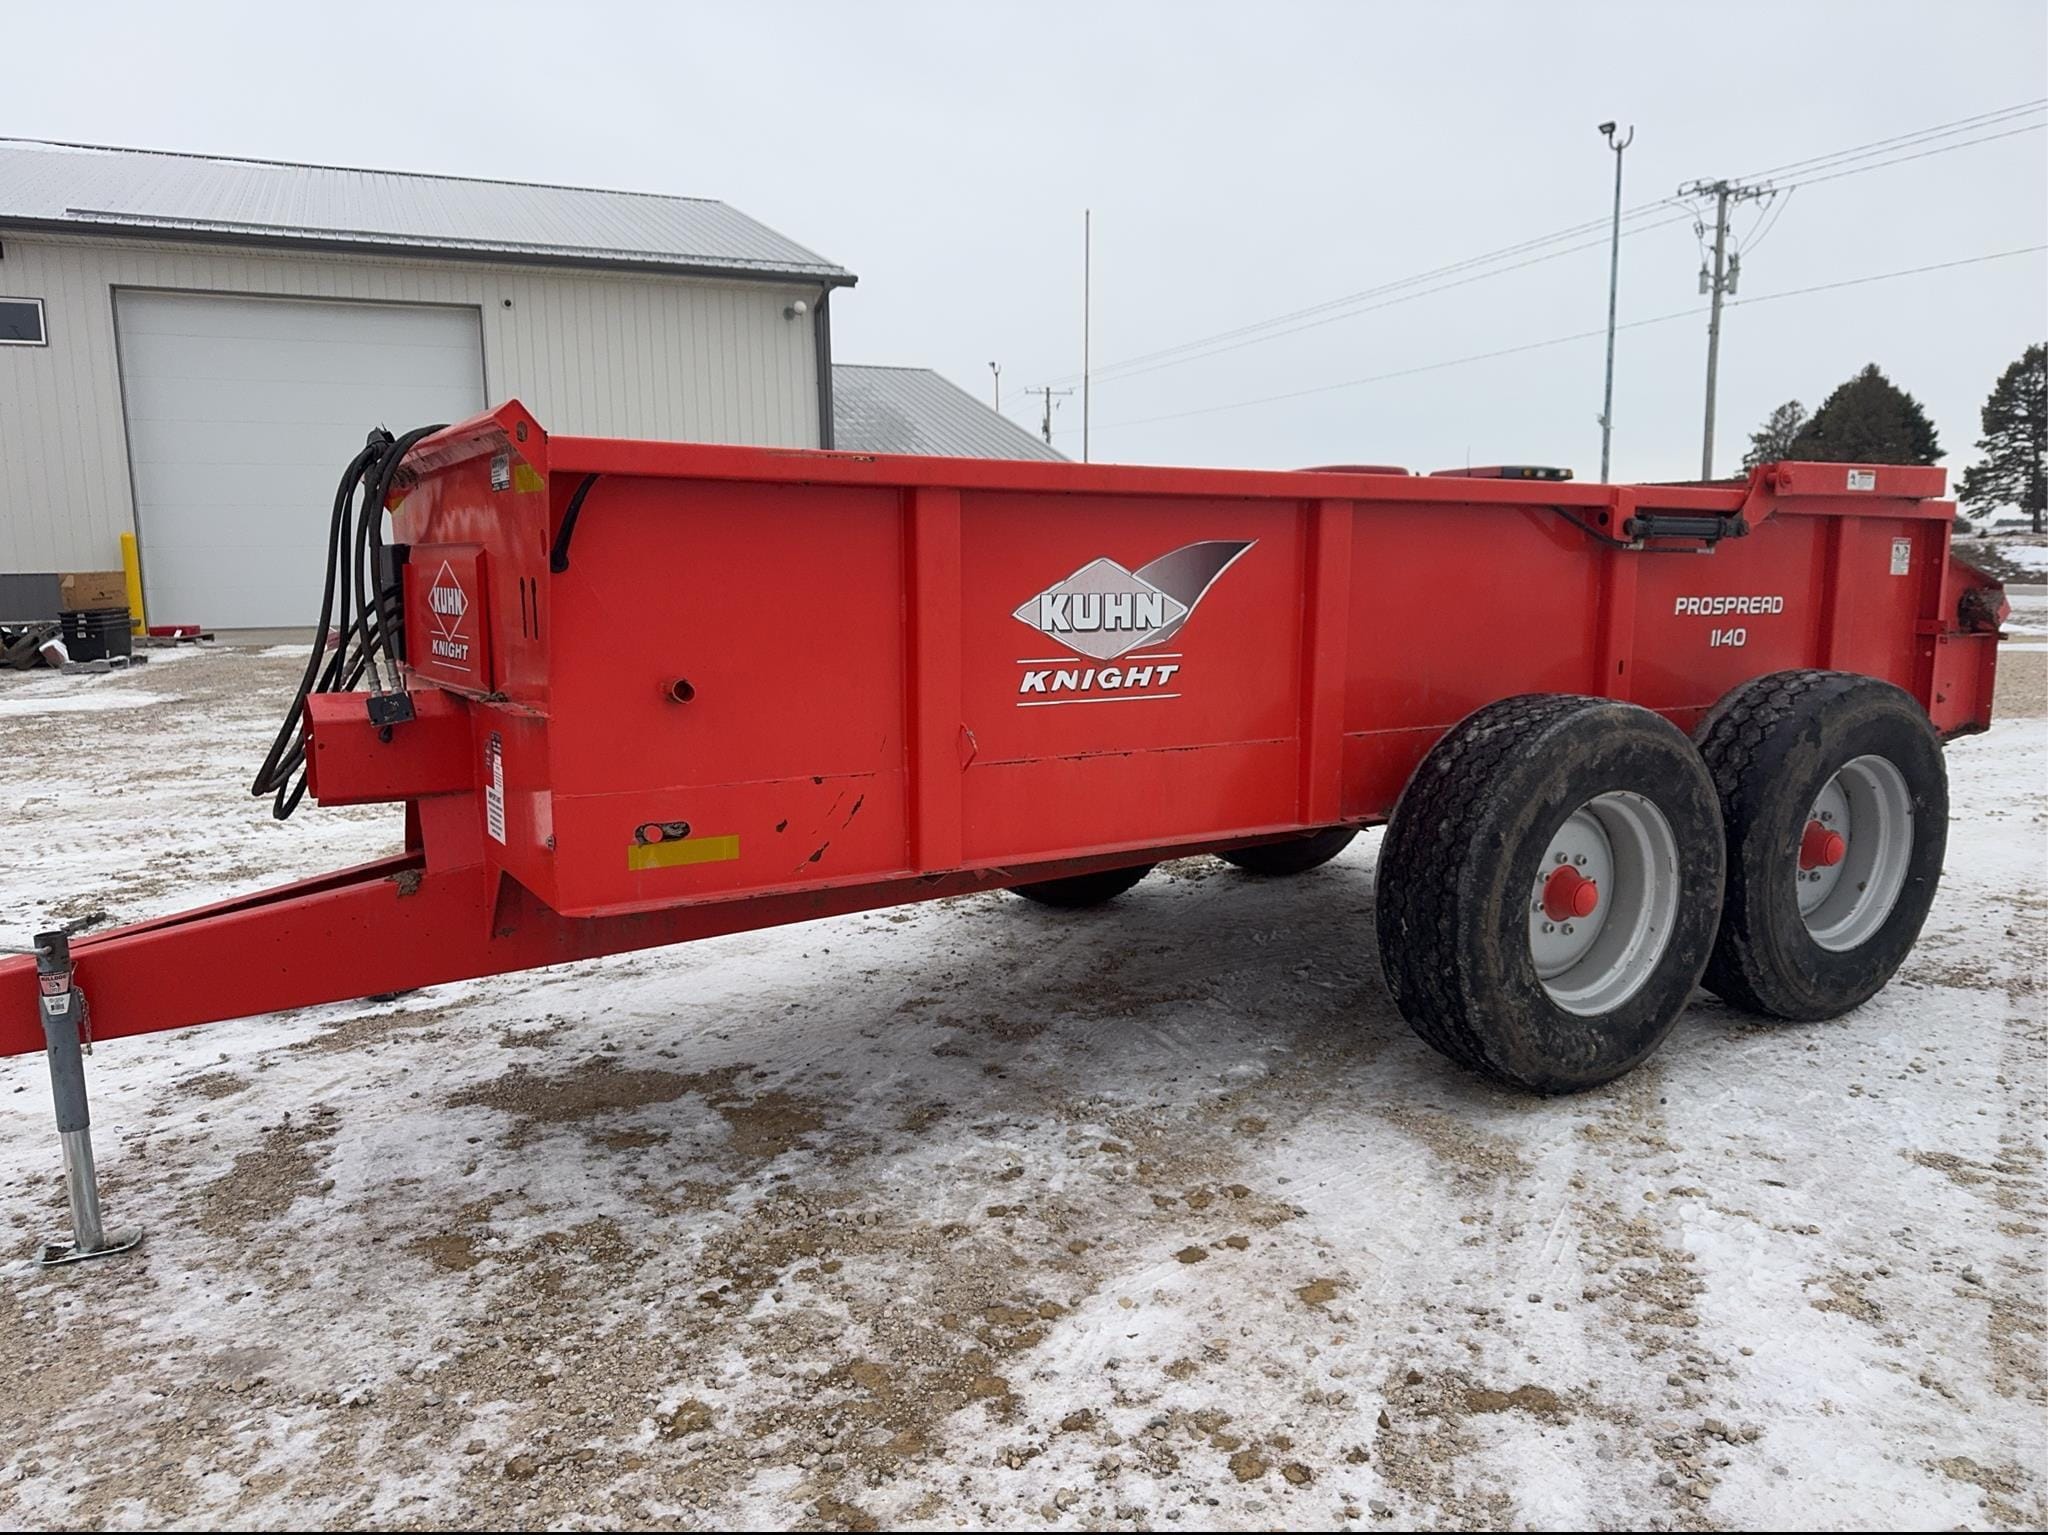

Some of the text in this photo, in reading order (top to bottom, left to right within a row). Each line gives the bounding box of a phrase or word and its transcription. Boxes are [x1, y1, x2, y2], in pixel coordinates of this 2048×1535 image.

[432, 586, 463, 616] KUHN
[1040, 592, 1163, 632] KUHN
[1675, 596, 1784, 616] PROSPREAD
[432, 639, 468, 661] KNIGHT
[1710, 628, 1747, 648] 1140
[1019, 664, 1180, 694] KNIGHT
